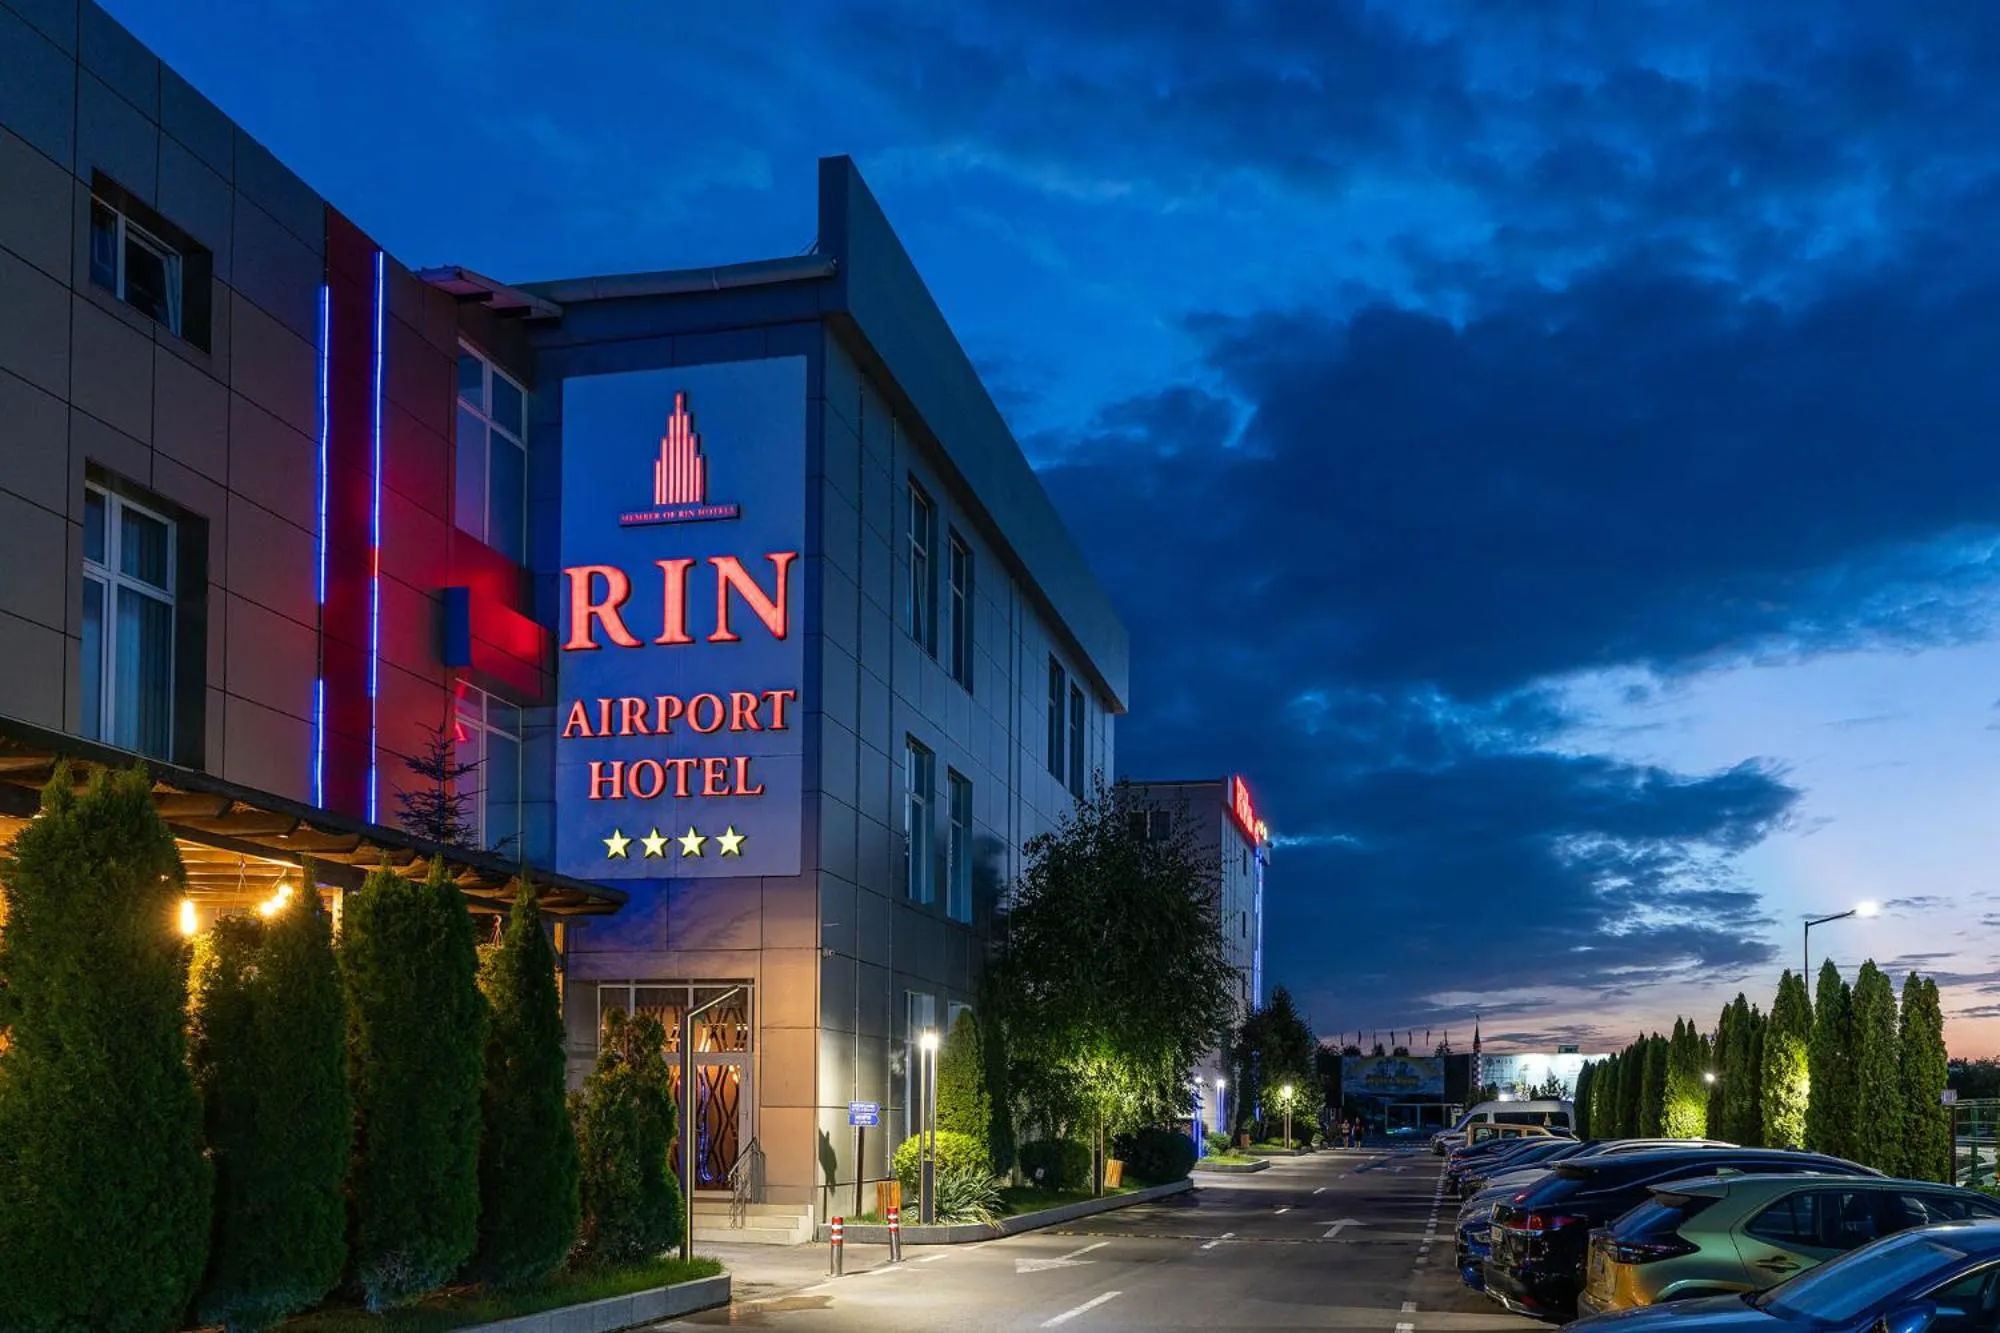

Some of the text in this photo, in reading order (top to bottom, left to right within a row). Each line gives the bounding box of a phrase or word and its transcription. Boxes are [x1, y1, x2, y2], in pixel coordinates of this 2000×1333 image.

[621, 512, 660, 522] MEMBER
[663, 511, 675, 519] OF
[679, 509, 695, 518] RIN
[561, 552, 798, 651] RIN
[562, 689, 796, 738] AIRPORT
[588, 756, 764, 800] HOTEL
